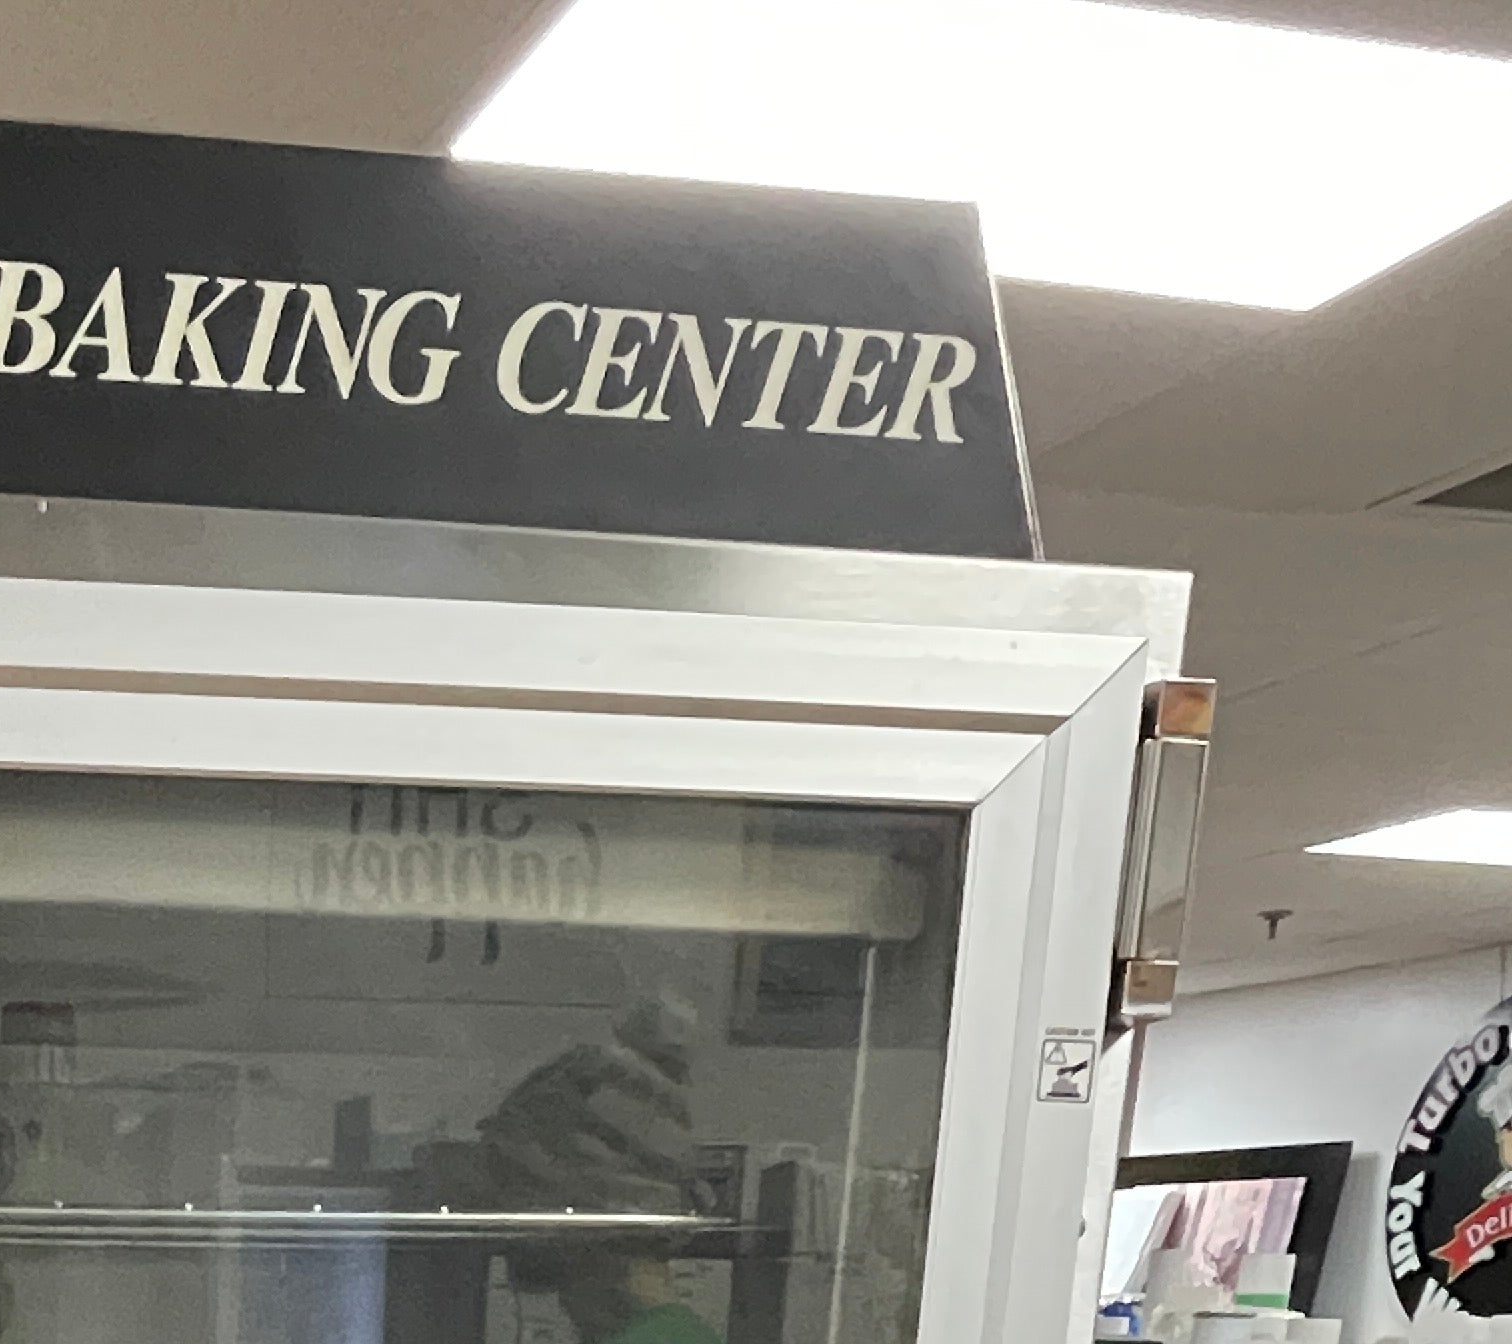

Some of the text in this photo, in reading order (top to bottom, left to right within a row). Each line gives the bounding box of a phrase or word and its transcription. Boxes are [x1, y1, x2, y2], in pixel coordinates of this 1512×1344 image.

[494, 299, 979, 445] CENTER
[1396, 1024, 1501, 1153] Turbo
[1388, 1170, 1426, 1280] Your
